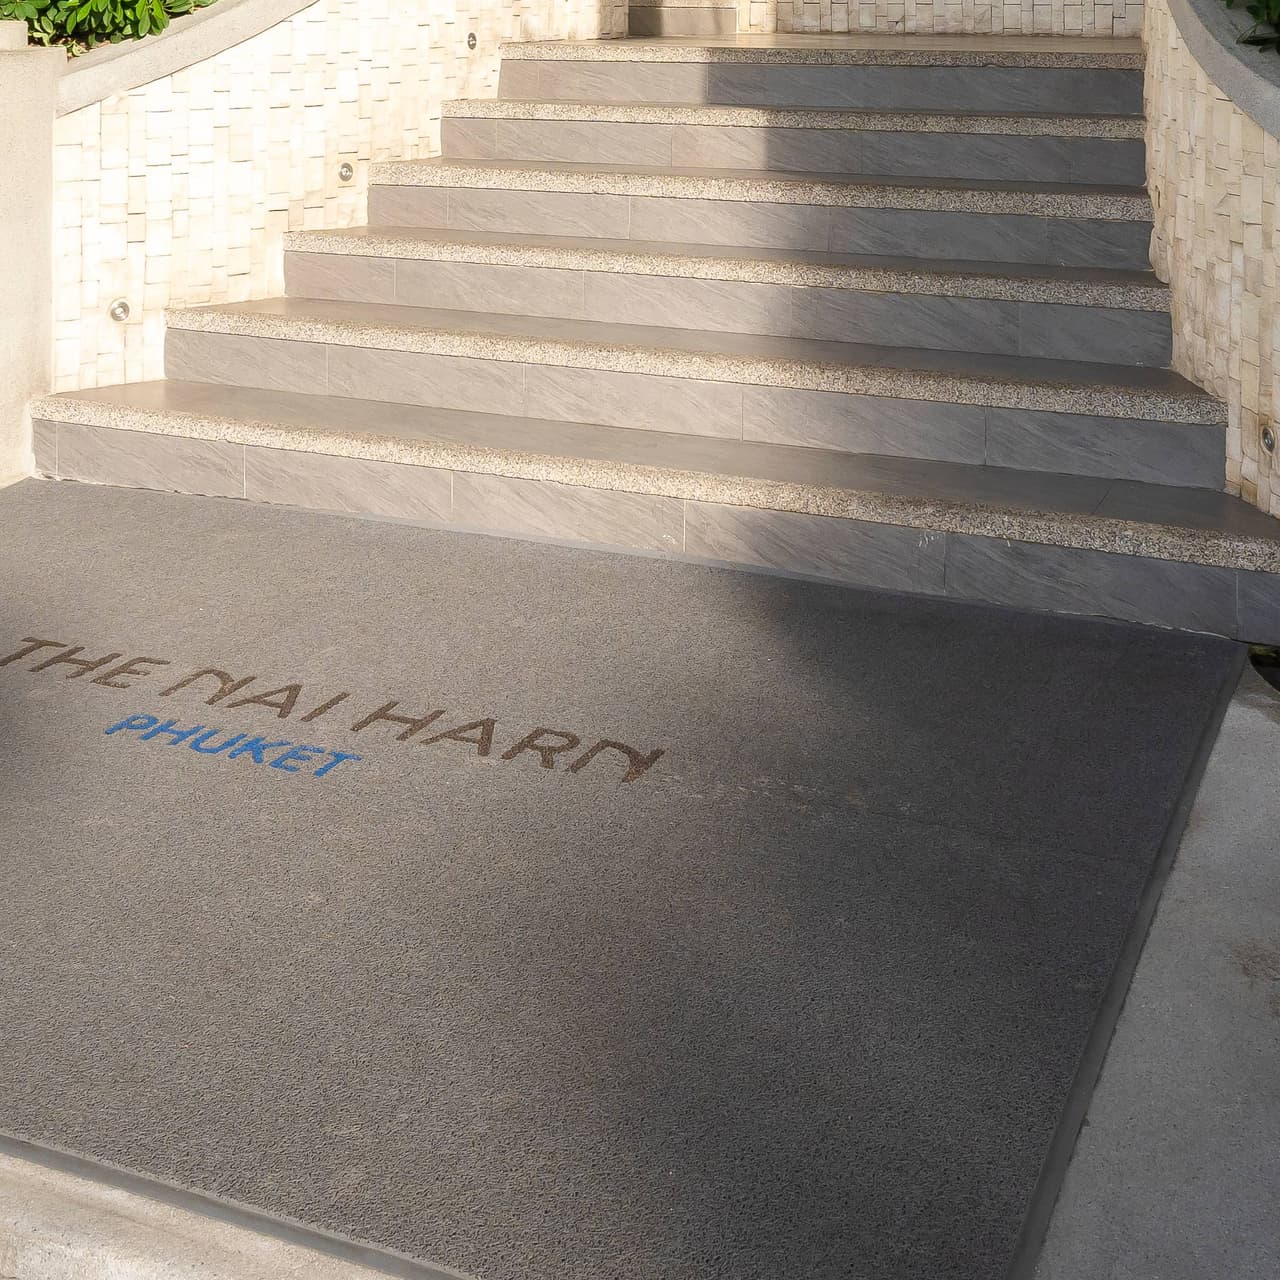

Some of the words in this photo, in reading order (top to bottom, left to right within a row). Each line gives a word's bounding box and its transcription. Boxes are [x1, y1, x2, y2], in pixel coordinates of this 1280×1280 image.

[104, 713, 363, 779] PHUKET
[158, 667, 351, 724] NAI
[351, 700, 666, 783] HARN
